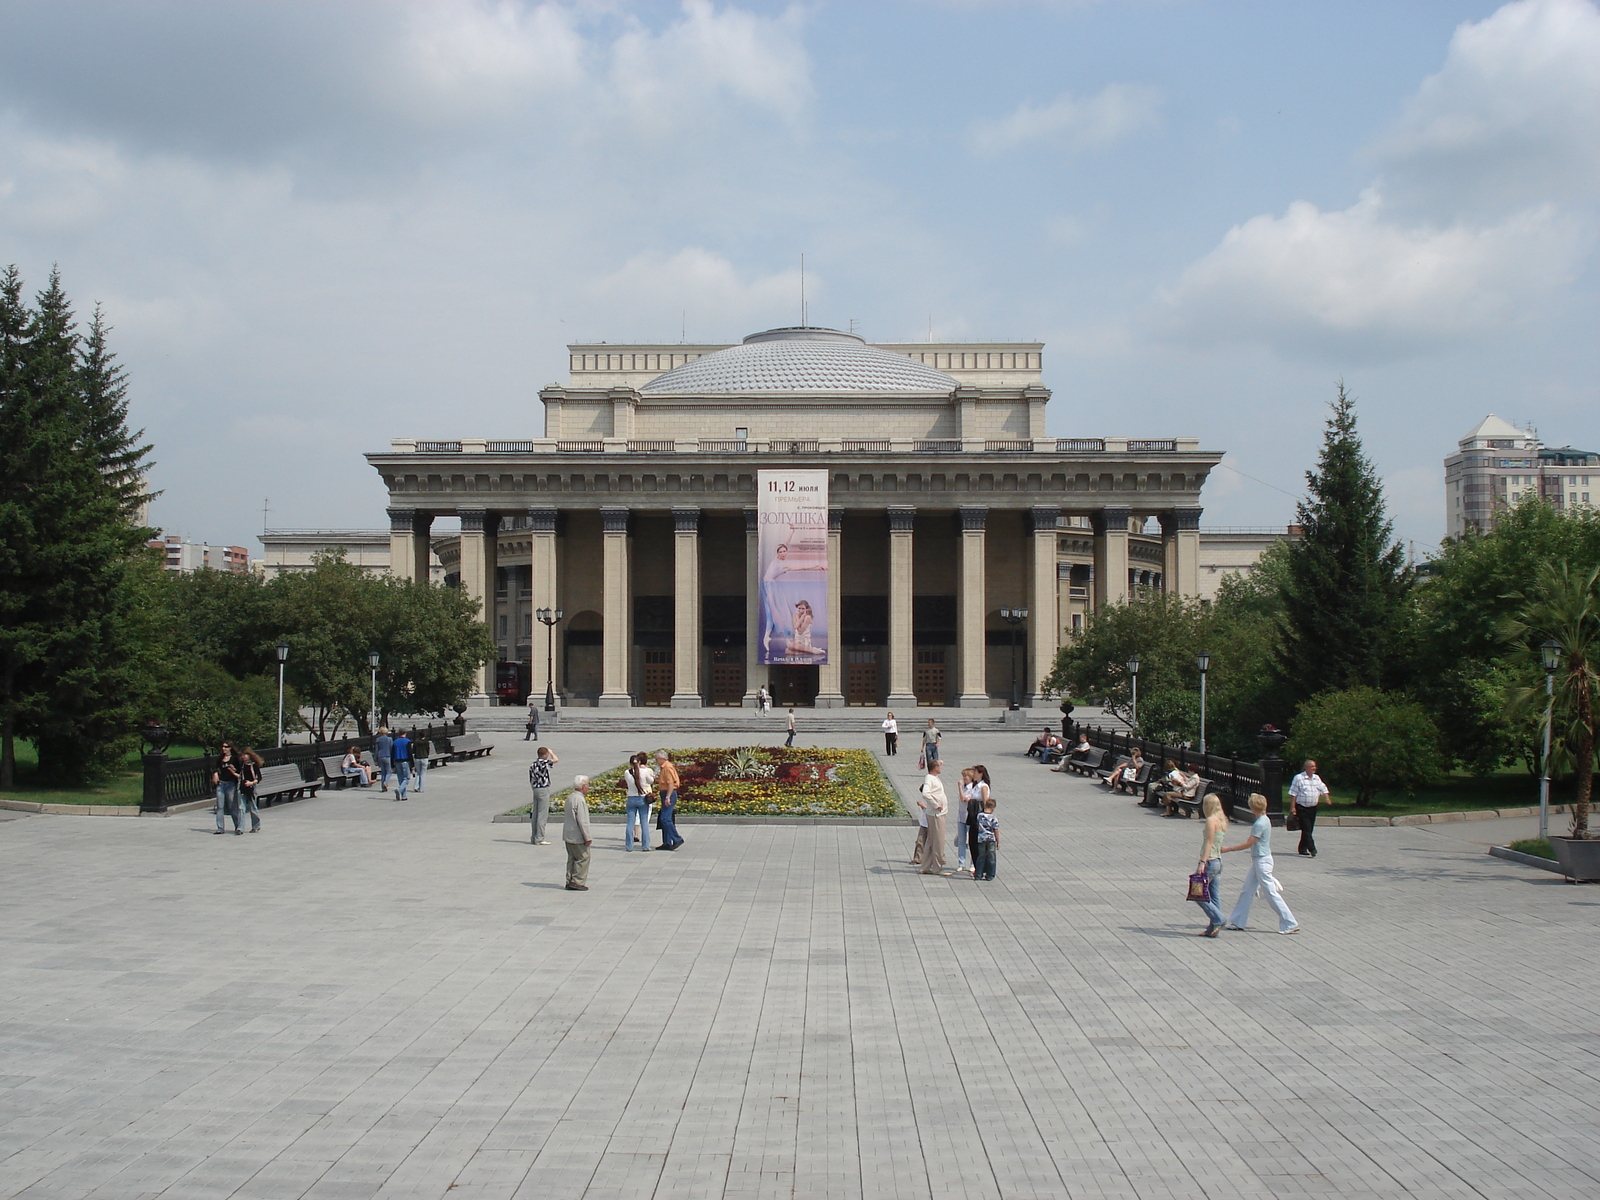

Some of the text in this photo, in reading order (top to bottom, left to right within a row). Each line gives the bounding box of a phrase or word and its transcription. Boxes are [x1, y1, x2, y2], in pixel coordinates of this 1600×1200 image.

[768, 481, 782, 493] 11,
[784, 481, 795, 492] 12
[760, 512, 825, 525] ЗОЛУШКА
